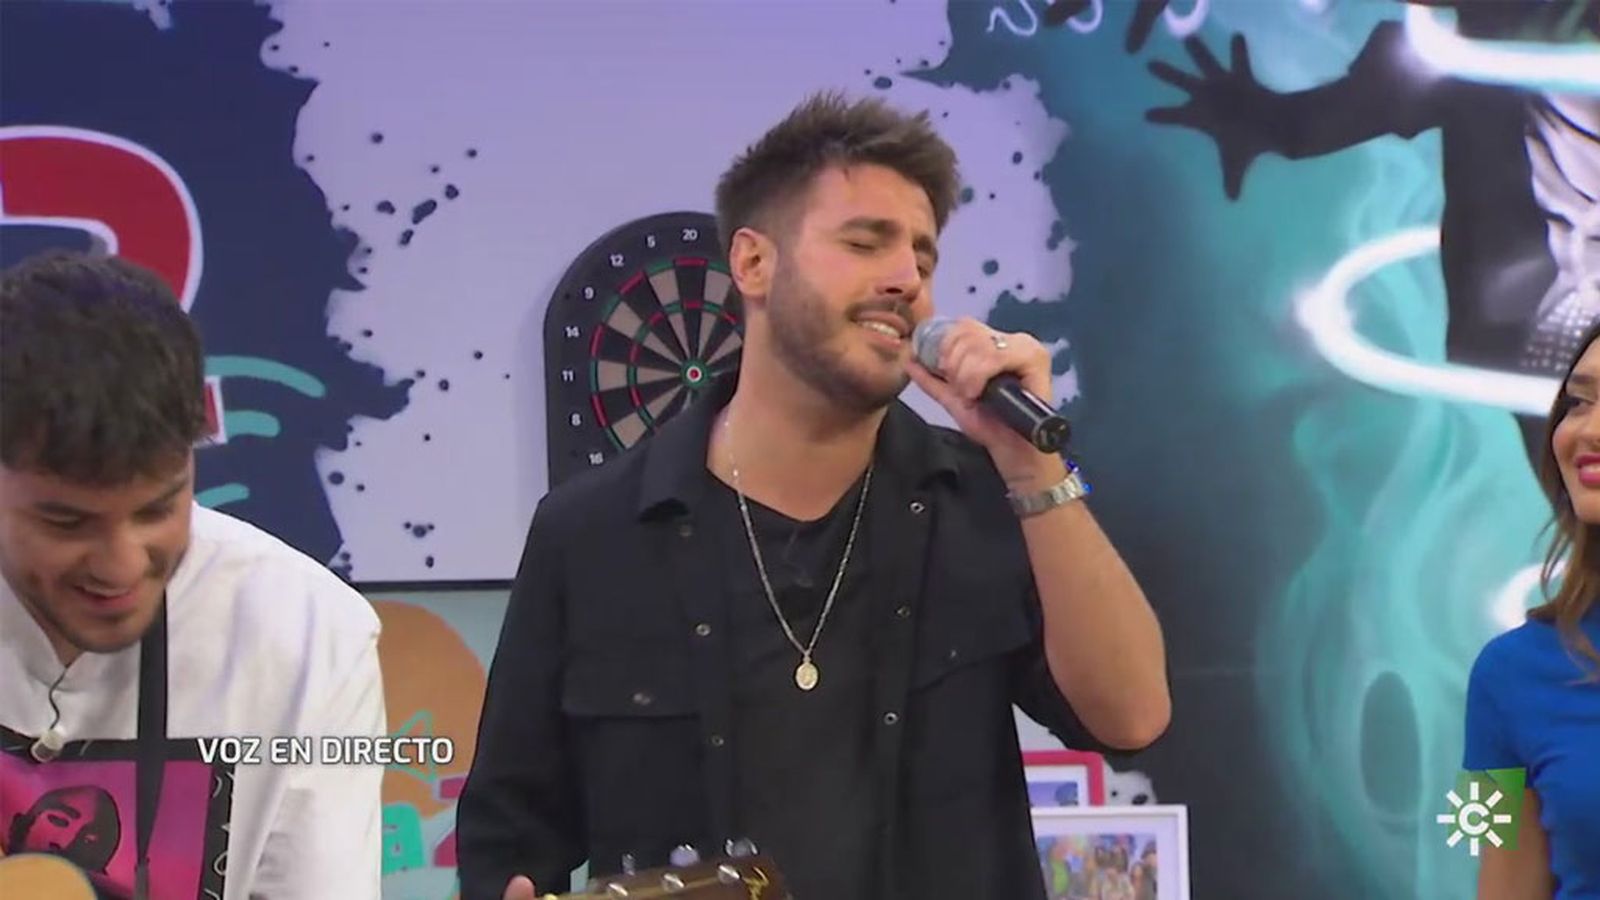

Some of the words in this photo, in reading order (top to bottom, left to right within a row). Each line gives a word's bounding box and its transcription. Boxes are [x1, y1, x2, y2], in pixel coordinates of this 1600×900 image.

[681, 228, 698, 241] 20
[646, 235, 656, 248] 5
[610, 253, 625, 267] 12
[584, 286, 594, 300] 9
[565, 325, 580, 338] 14
[562, 369, 574, 382] 11
[571, 413, 582, 426] 8
[588, 452, 604, 465] 16
